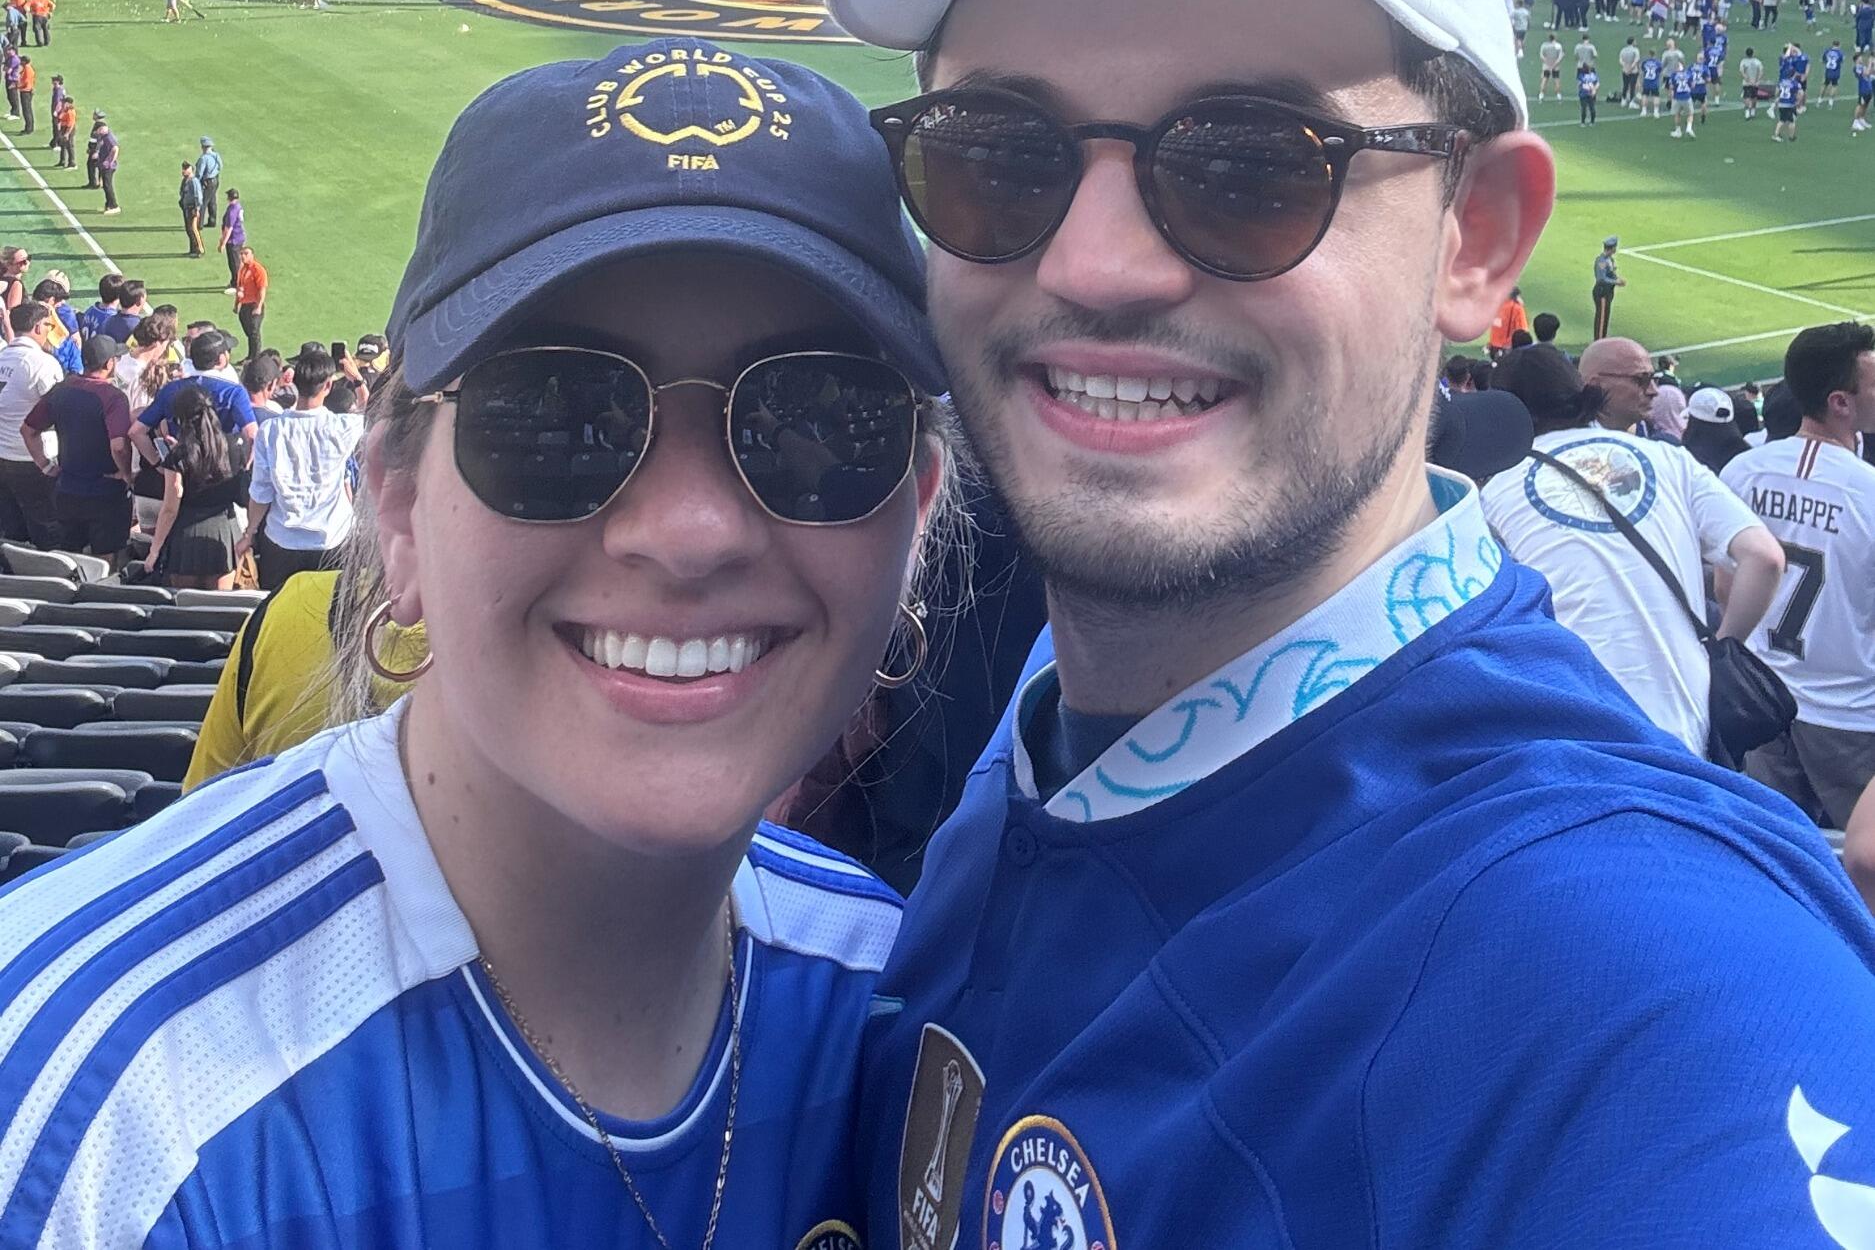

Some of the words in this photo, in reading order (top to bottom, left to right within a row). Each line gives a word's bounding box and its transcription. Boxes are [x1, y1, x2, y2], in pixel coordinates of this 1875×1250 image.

[586, 80, 619, 138] CLUB
[617, 49, 732, 75] WORLD
[742, 67, 787, 104] CUP
[769, 110, 792, 141] 25
[667, 154, 719, 170] FIFA
[1752, 486, 1843, 534] MBAPPE
[1768, 541, 1826, 661] 7
[1011, 1138, 1090, 1207] CHELSEA
[912, 1186, 938, 1246] FIFA
